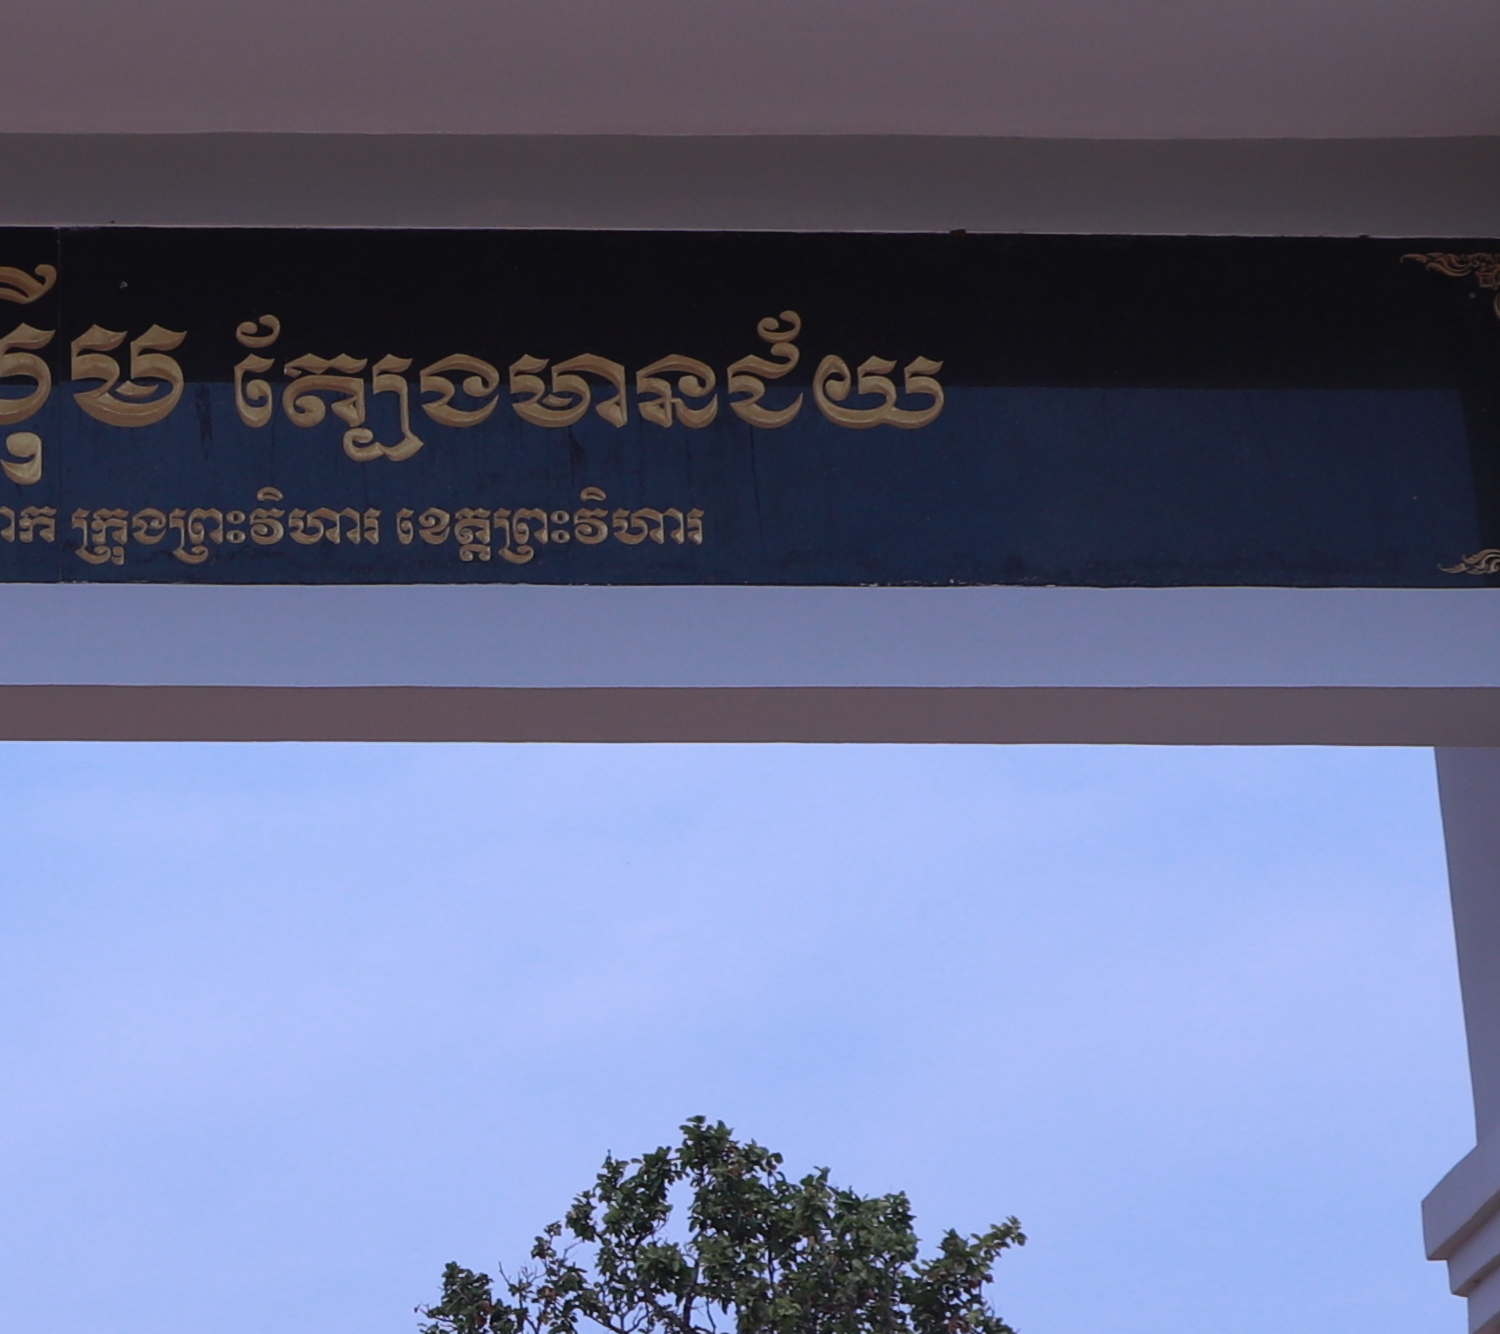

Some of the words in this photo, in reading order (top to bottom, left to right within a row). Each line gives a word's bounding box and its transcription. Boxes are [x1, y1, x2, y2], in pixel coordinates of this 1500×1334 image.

[71, 486, 382, 566] ក្រុងព្រះវិហារ
